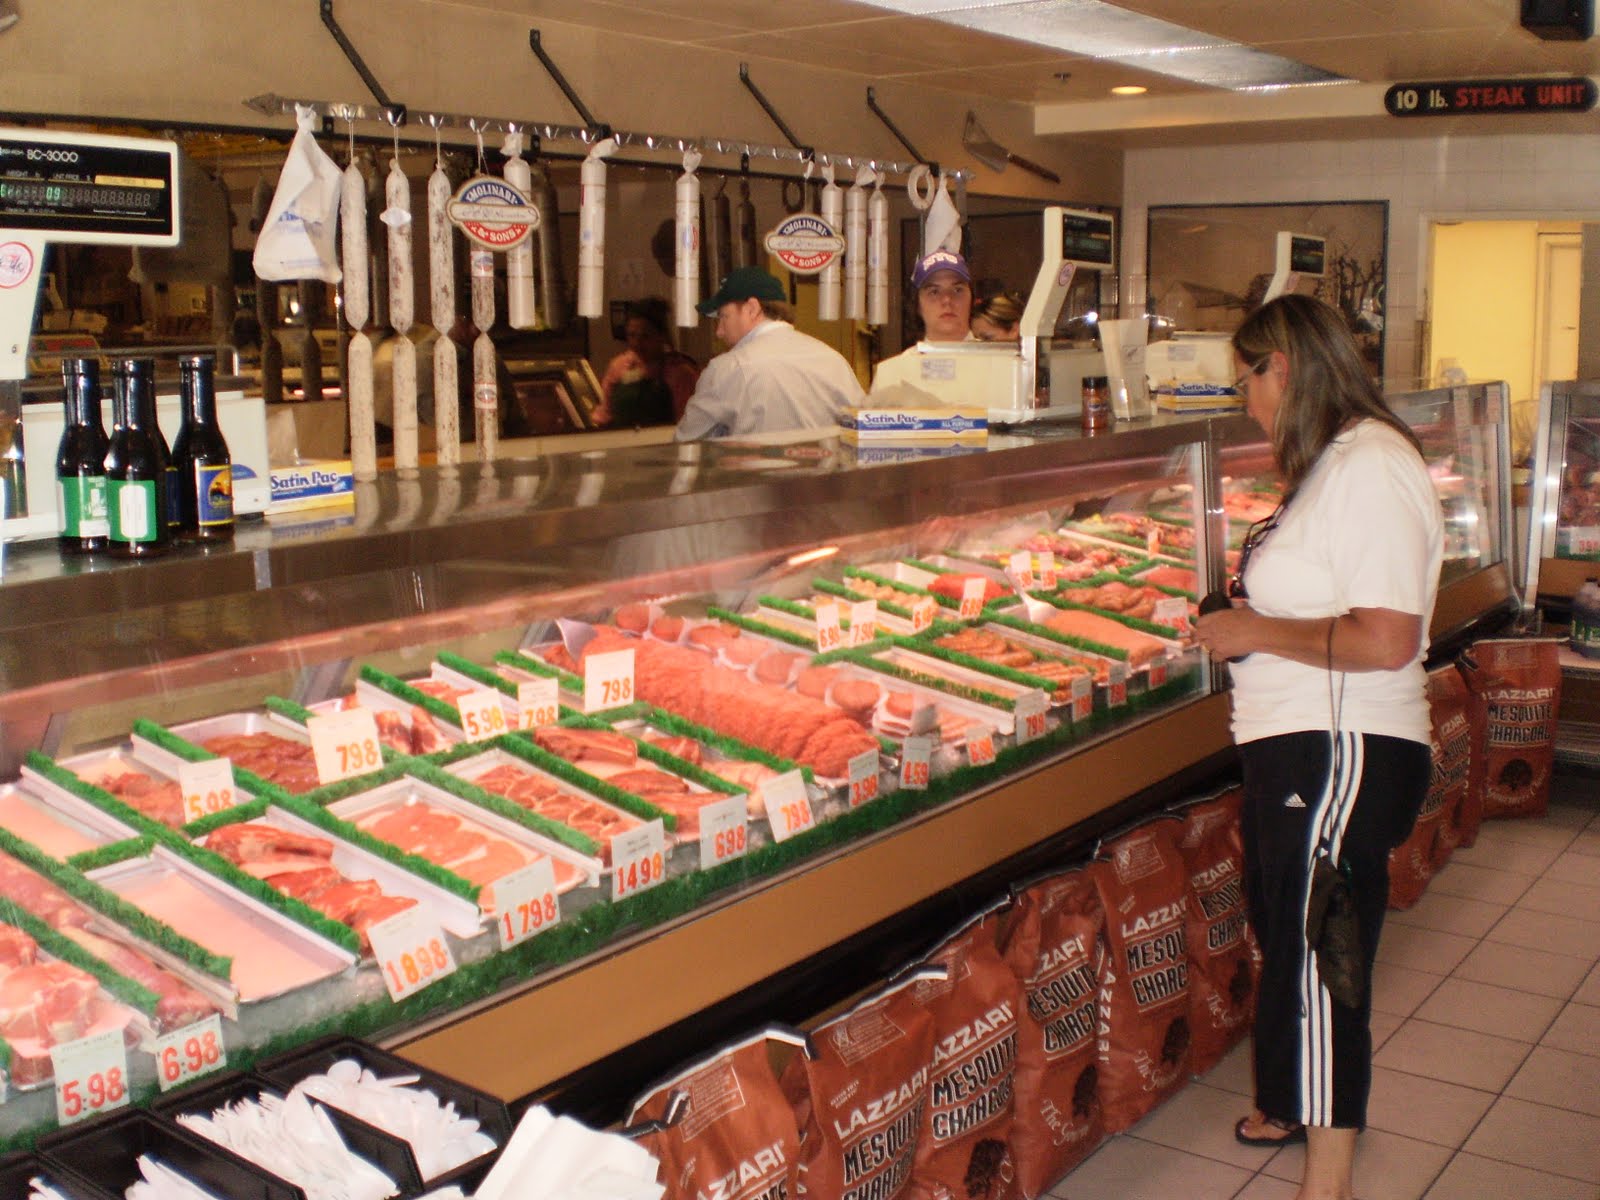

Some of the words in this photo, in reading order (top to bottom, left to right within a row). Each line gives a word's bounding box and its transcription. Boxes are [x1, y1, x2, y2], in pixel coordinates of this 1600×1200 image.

[1396, 89, 1418, 110] 10
[1429, 88, 1449, 108] lb.
[1455, 86, 1525, 107] STEAK
[1536, 84, 1586, 105] UNIT
[26, 149, 78, 163] BC-3000
[489, 227, 517, 242] SONS
[798, 256, 822, 267] SONS
[864, 413, 896, 424] Satin
[897, 413, 918, 423] Pac
[270, 473, 309, 490] Satin
[311, 471, 337, 484] Pac
[336, 738, 378, 773] 798
[1131, 960, 1189, 1006] CHARC
[833, 1066, 928, 1140] LAZZARI
